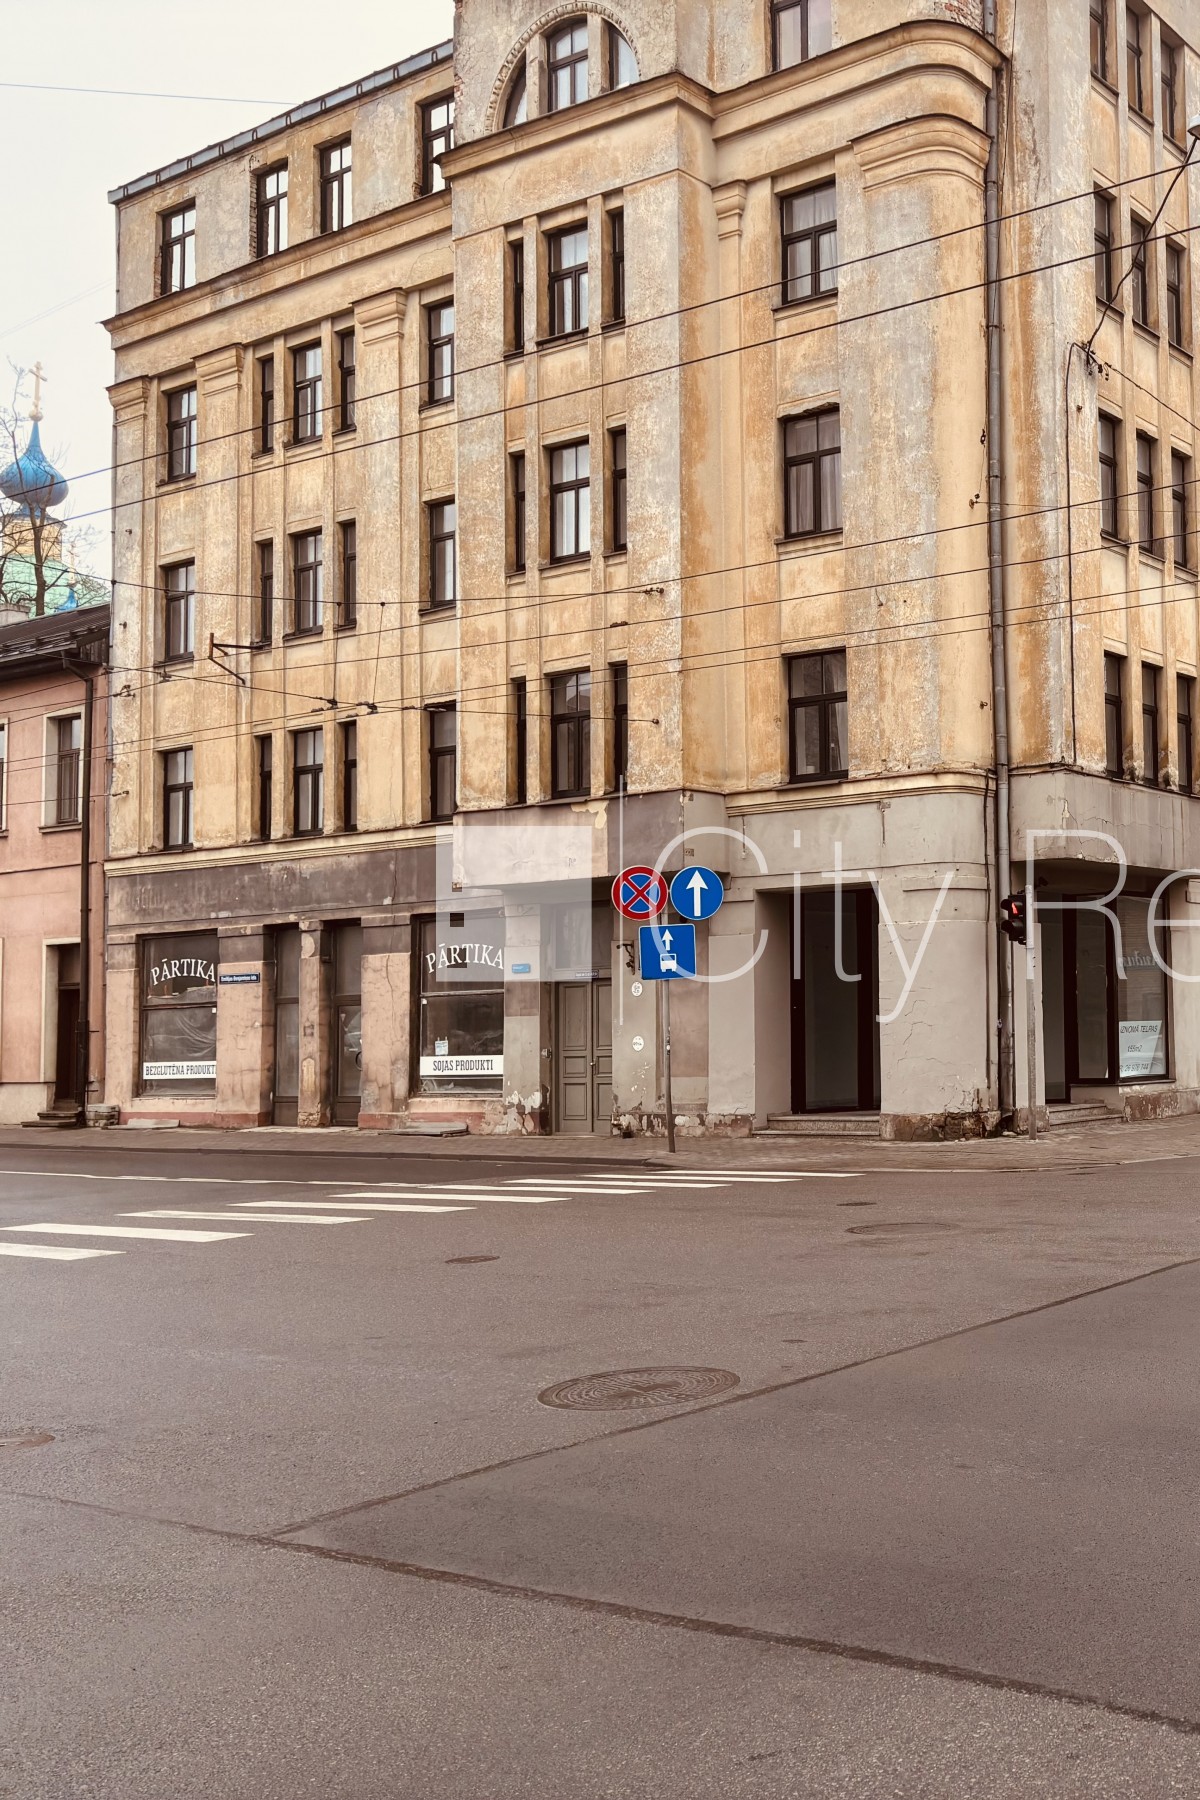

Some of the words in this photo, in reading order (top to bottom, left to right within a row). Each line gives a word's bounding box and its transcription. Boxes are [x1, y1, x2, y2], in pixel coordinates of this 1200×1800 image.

[425, 943, 504, 973] PĀRTIKA
[151, 958, 216, 986] PĀRTIKA
[145, 1063, 184, 1076] BEZGLUTĒNA
[433, 1060, 453, 1072] SOJAS
[455, 1059, 494, 1071] PRODUKTI
